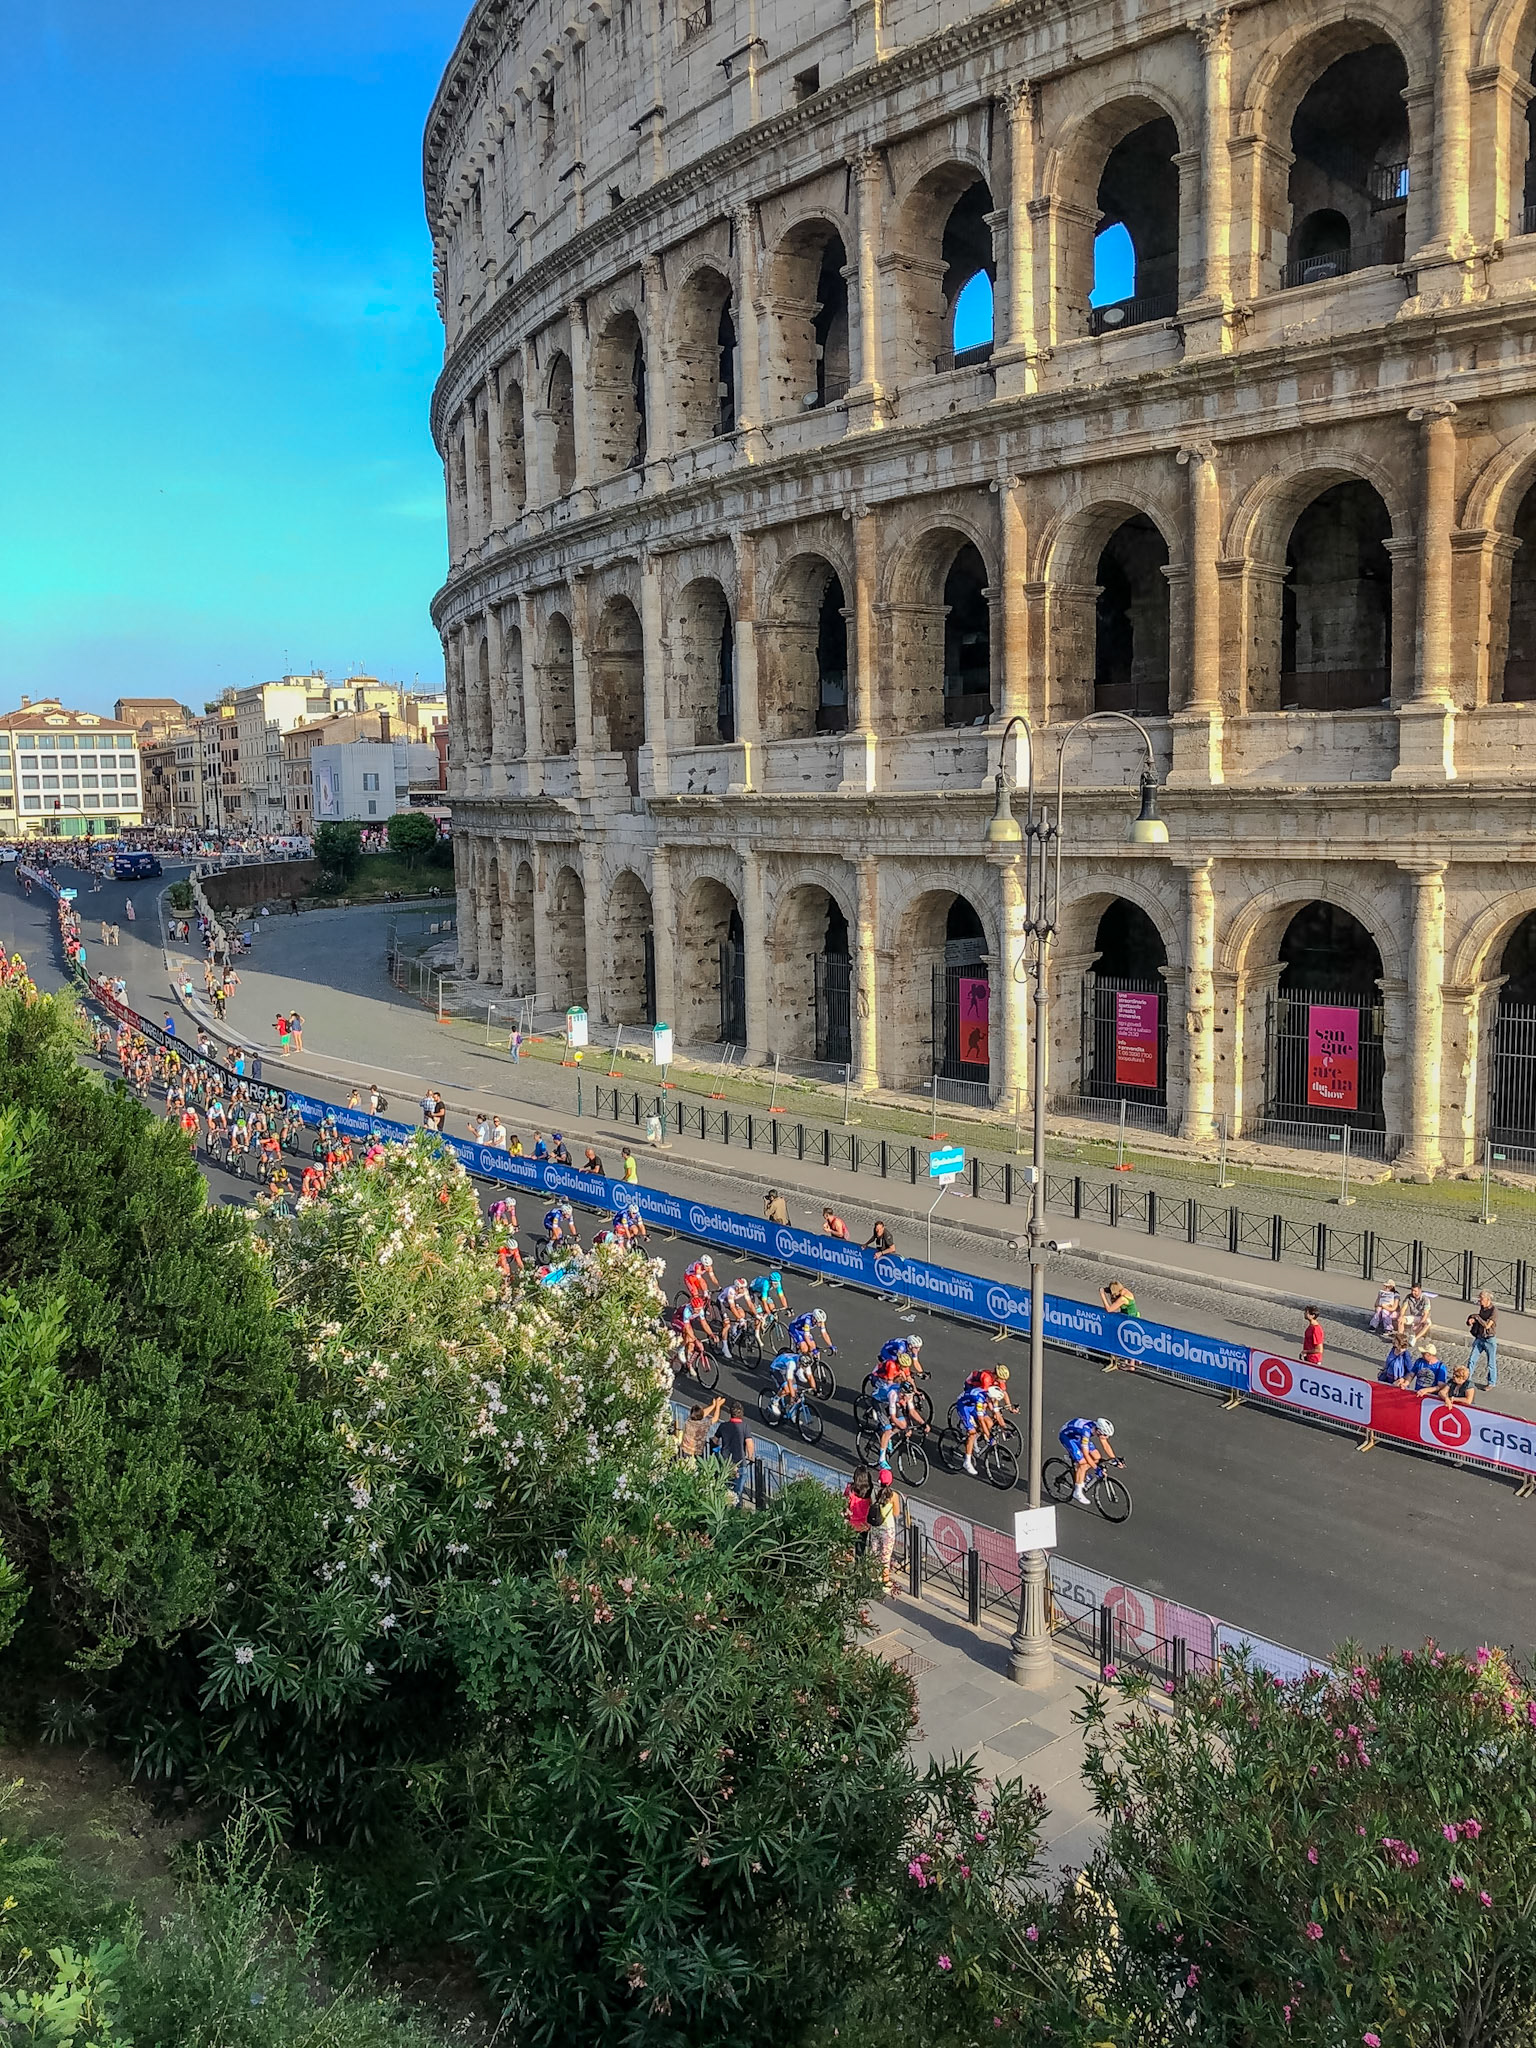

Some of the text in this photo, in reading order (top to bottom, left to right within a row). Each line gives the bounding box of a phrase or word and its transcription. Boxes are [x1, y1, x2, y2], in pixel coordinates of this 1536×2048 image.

[483, 1155, 537, 1179] mediolanum
[547, 1171, 605, 1198] mediolanum
[590, 1178, 604, 1187] BANCA
[616, 1190, 682, 1219] mediolanum
[664, 1199, 680, 1209] BANCA
[693, 1211, 766, 1243] mediolanum
[748, 1222, 765, 1232] BANCA
[779, 1235, 863, 1271] mediolanum
[842, 1247, 862, 1258] BANCA
[878, 1261, 974, 1302] mediolanum
[951, 1277, 973, 1289] BANCA
[991, 1296, 1103, 1336] medlanum
[1076, 1309, 1101, 1322] BANCA
[1123, 1328, 1248, 1375] mediolanum
[1219, 1347, 1247, 1360] BANCA
[1300, 1376, 1364, 1410] casa.it
